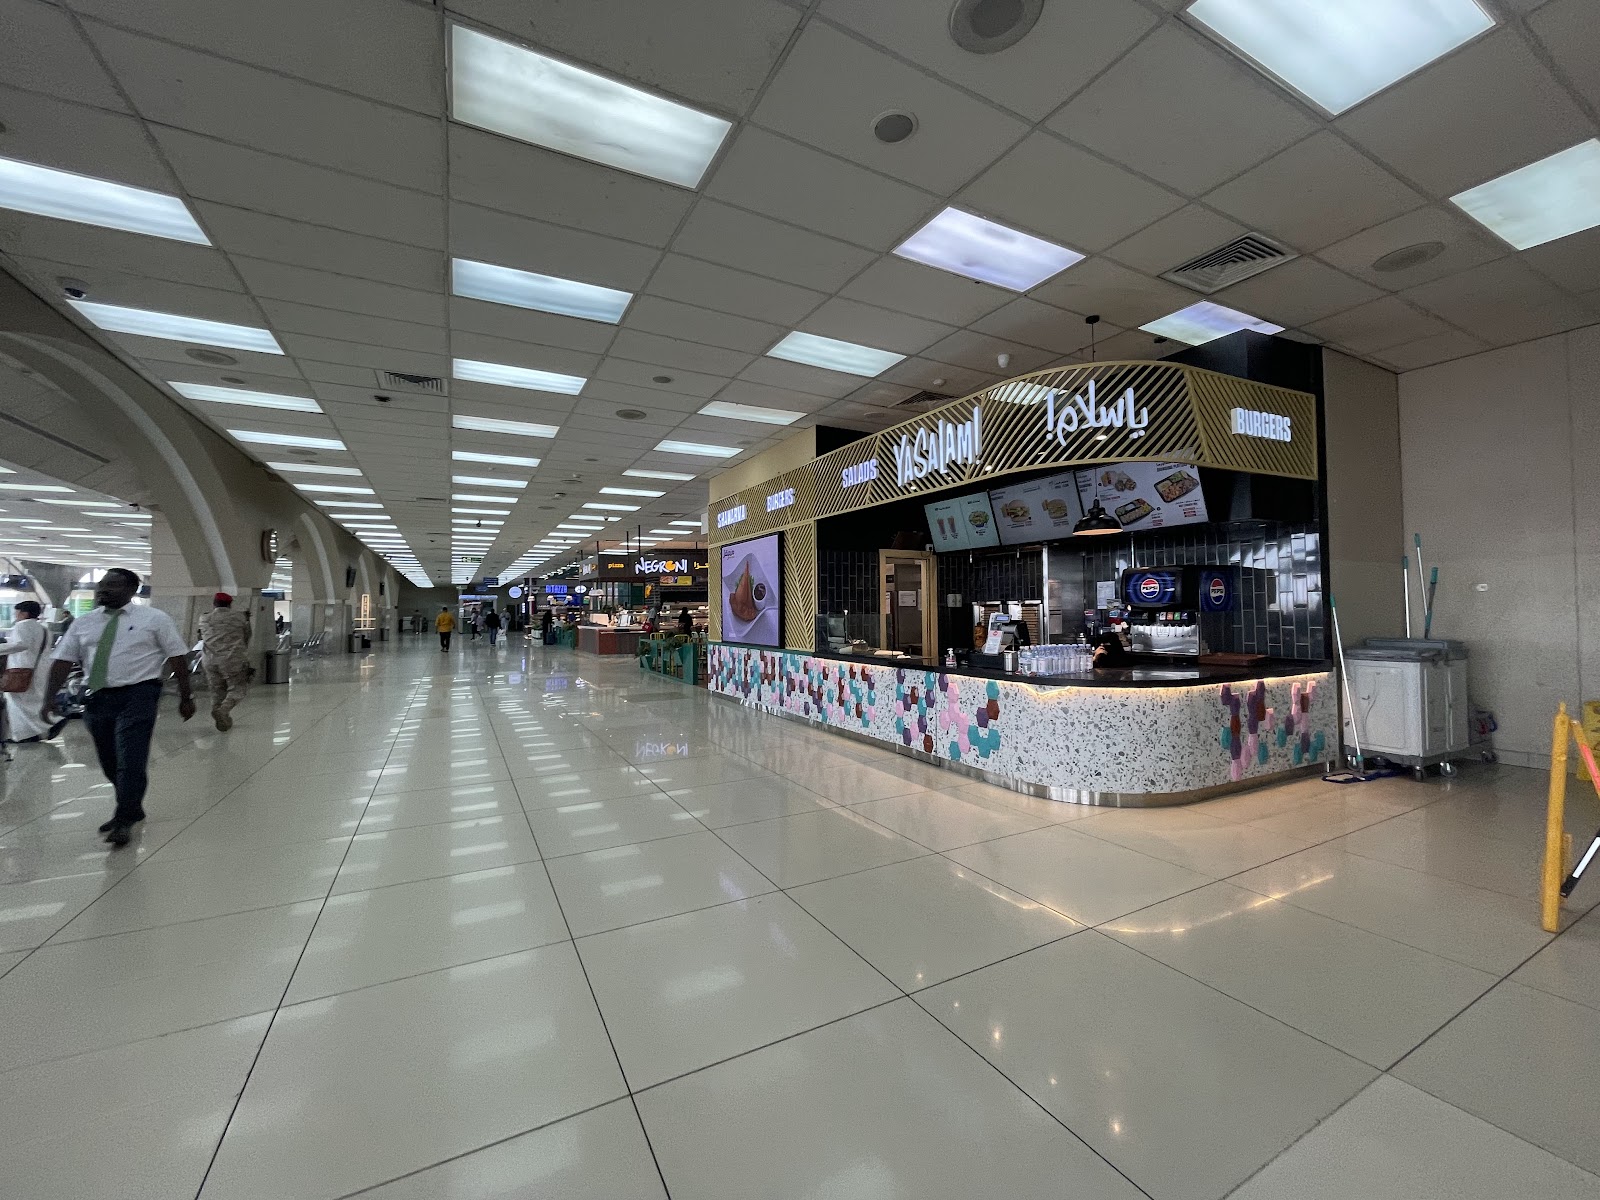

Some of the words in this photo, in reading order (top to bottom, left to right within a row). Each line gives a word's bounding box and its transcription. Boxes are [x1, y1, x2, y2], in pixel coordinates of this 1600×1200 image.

[1231, 407, 1292, 442] BURGERS
[842, 458, 879, 488] SALADS
[766, 487, 795, 512] BURGERS
[635, 556, 688, 574] NEGRONI
